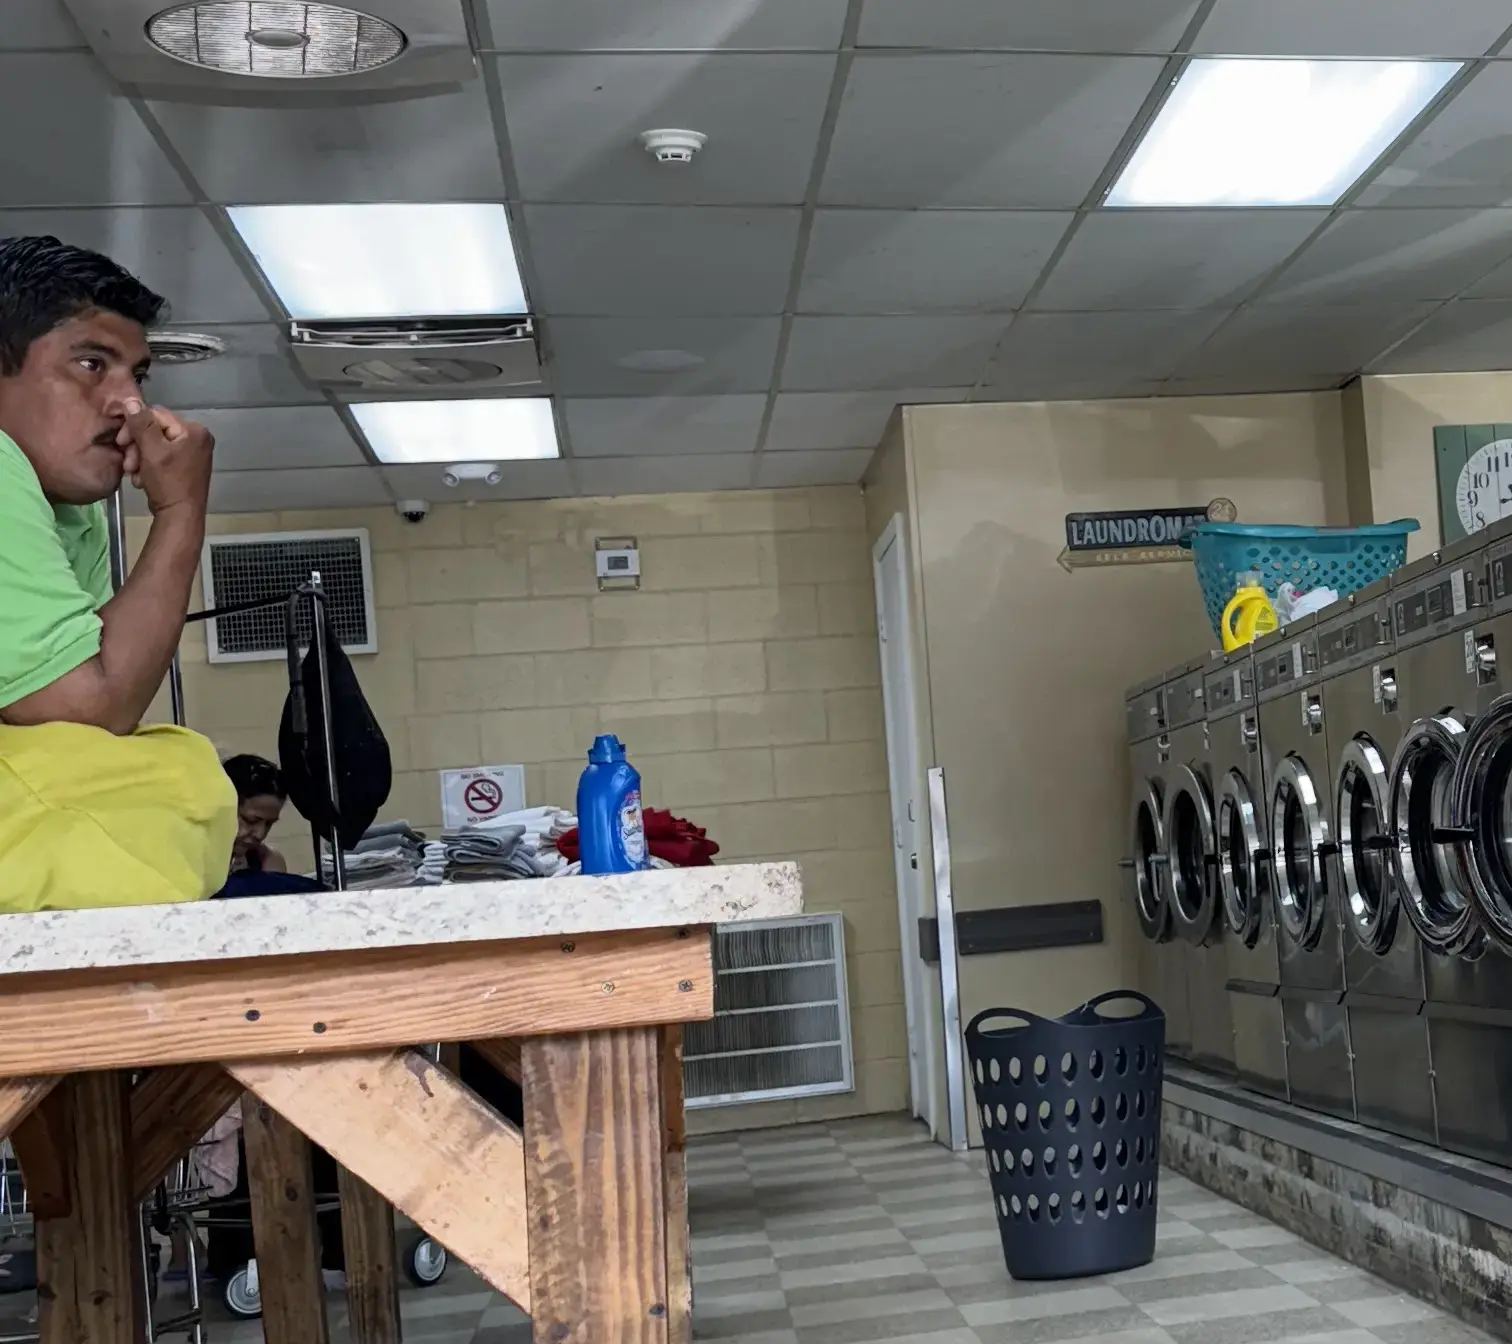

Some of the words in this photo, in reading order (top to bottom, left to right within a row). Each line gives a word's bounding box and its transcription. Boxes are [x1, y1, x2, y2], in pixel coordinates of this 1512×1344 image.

[1487, 456, 1500, 473] 11
[1473, 472, 1490, 489] 10
[1467, 490, 1478, 507] 9
[1475, 511, 1486, 528] 8
[1140, 549, 1190, 561] SERVIC
